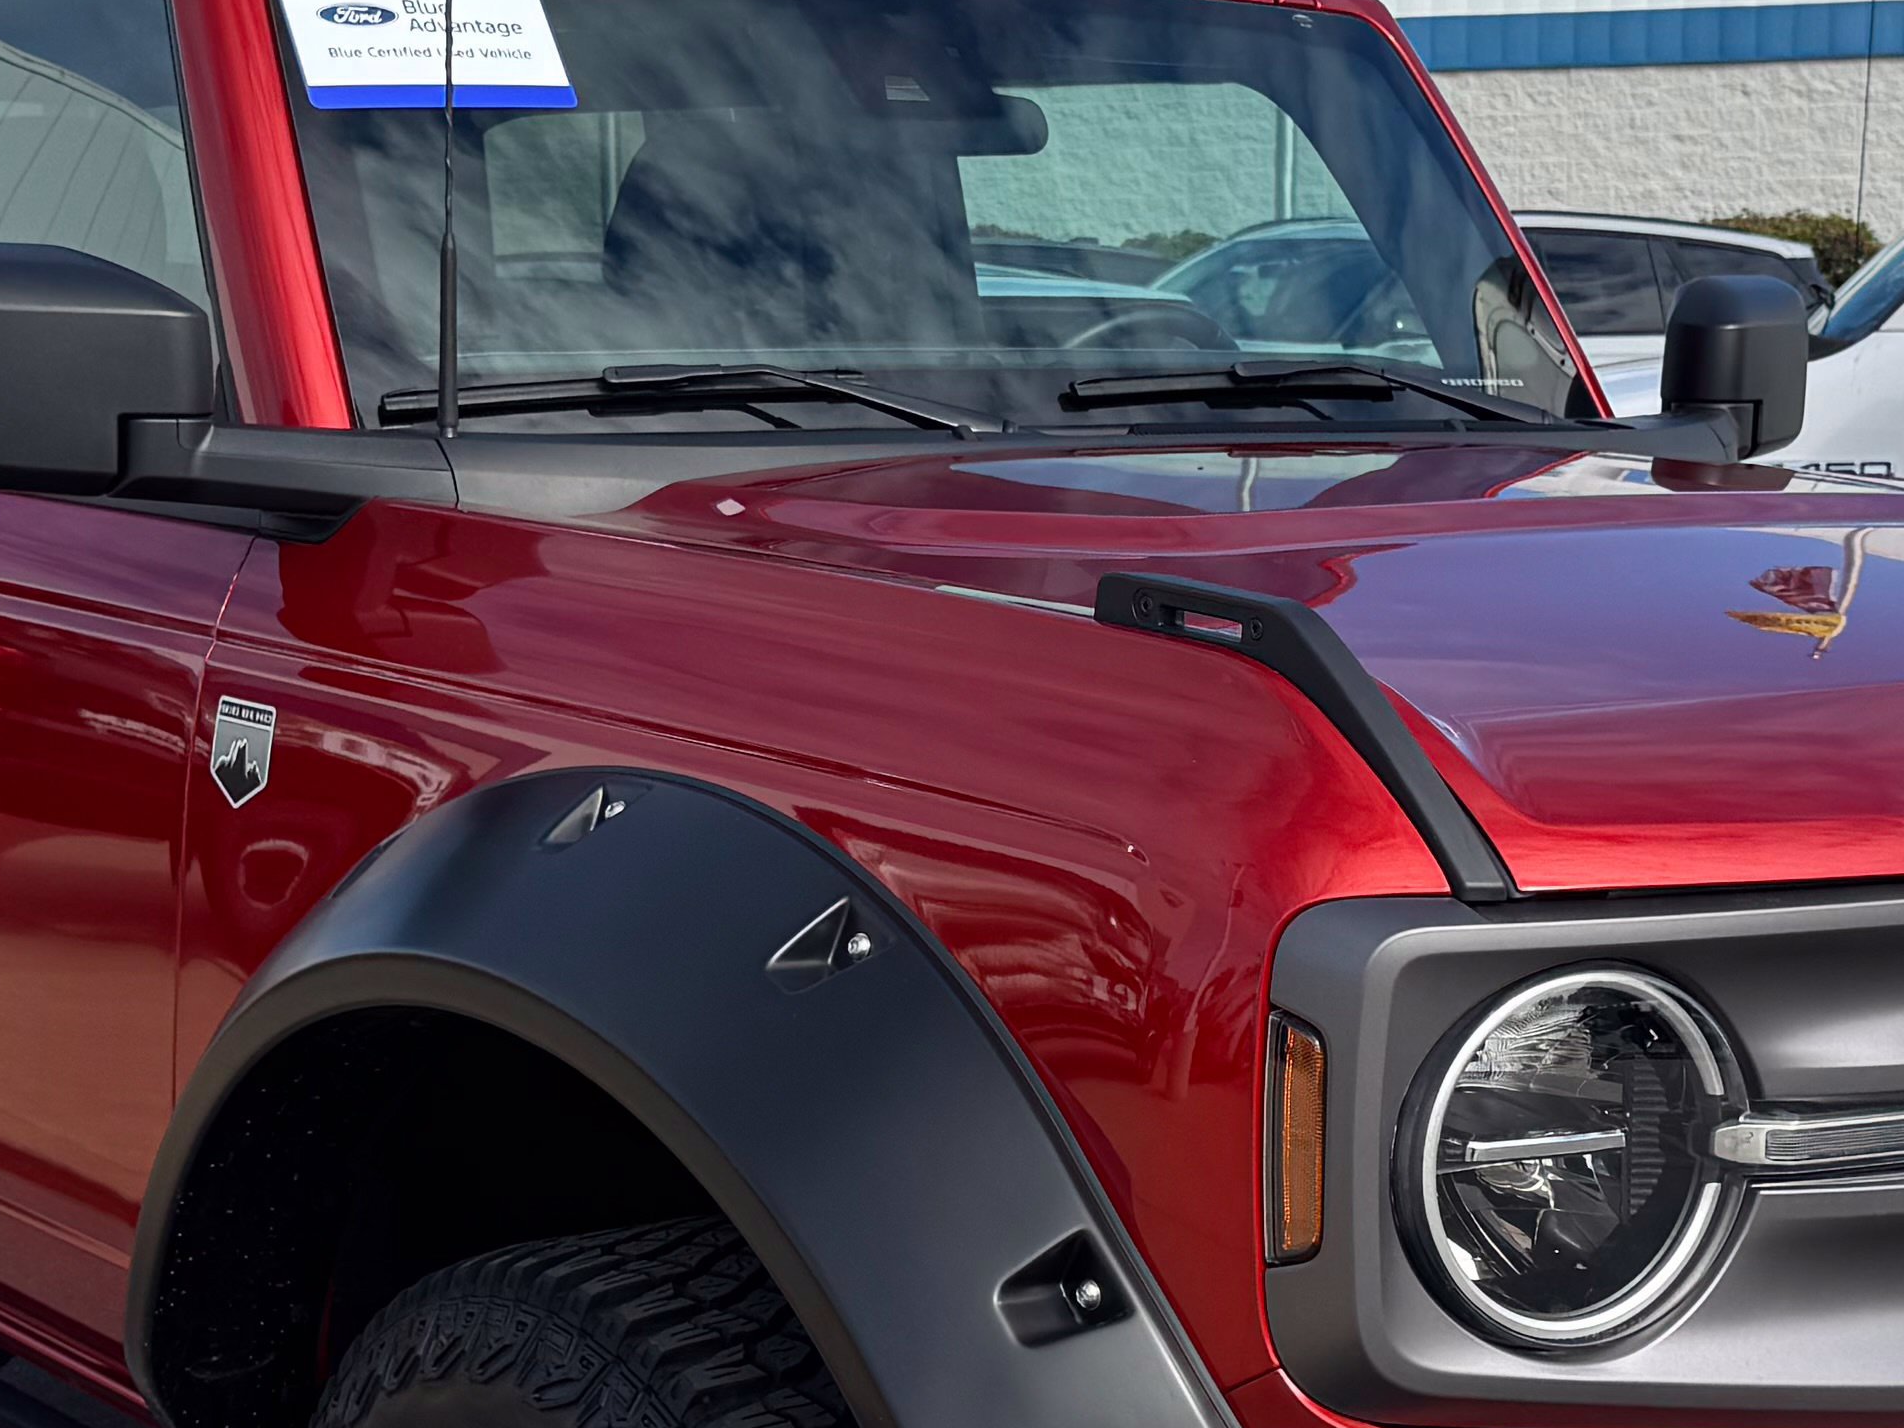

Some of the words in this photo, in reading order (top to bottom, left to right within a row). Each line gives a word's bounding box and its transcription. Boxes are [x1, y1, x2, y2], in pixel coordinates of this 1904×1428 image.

[409, 17, 523, 37] Advantage
[328, 47, 363, 59] Blue
[367, 46, 432, 58] Certified
[479, 48, 532, 60] Vehicle
